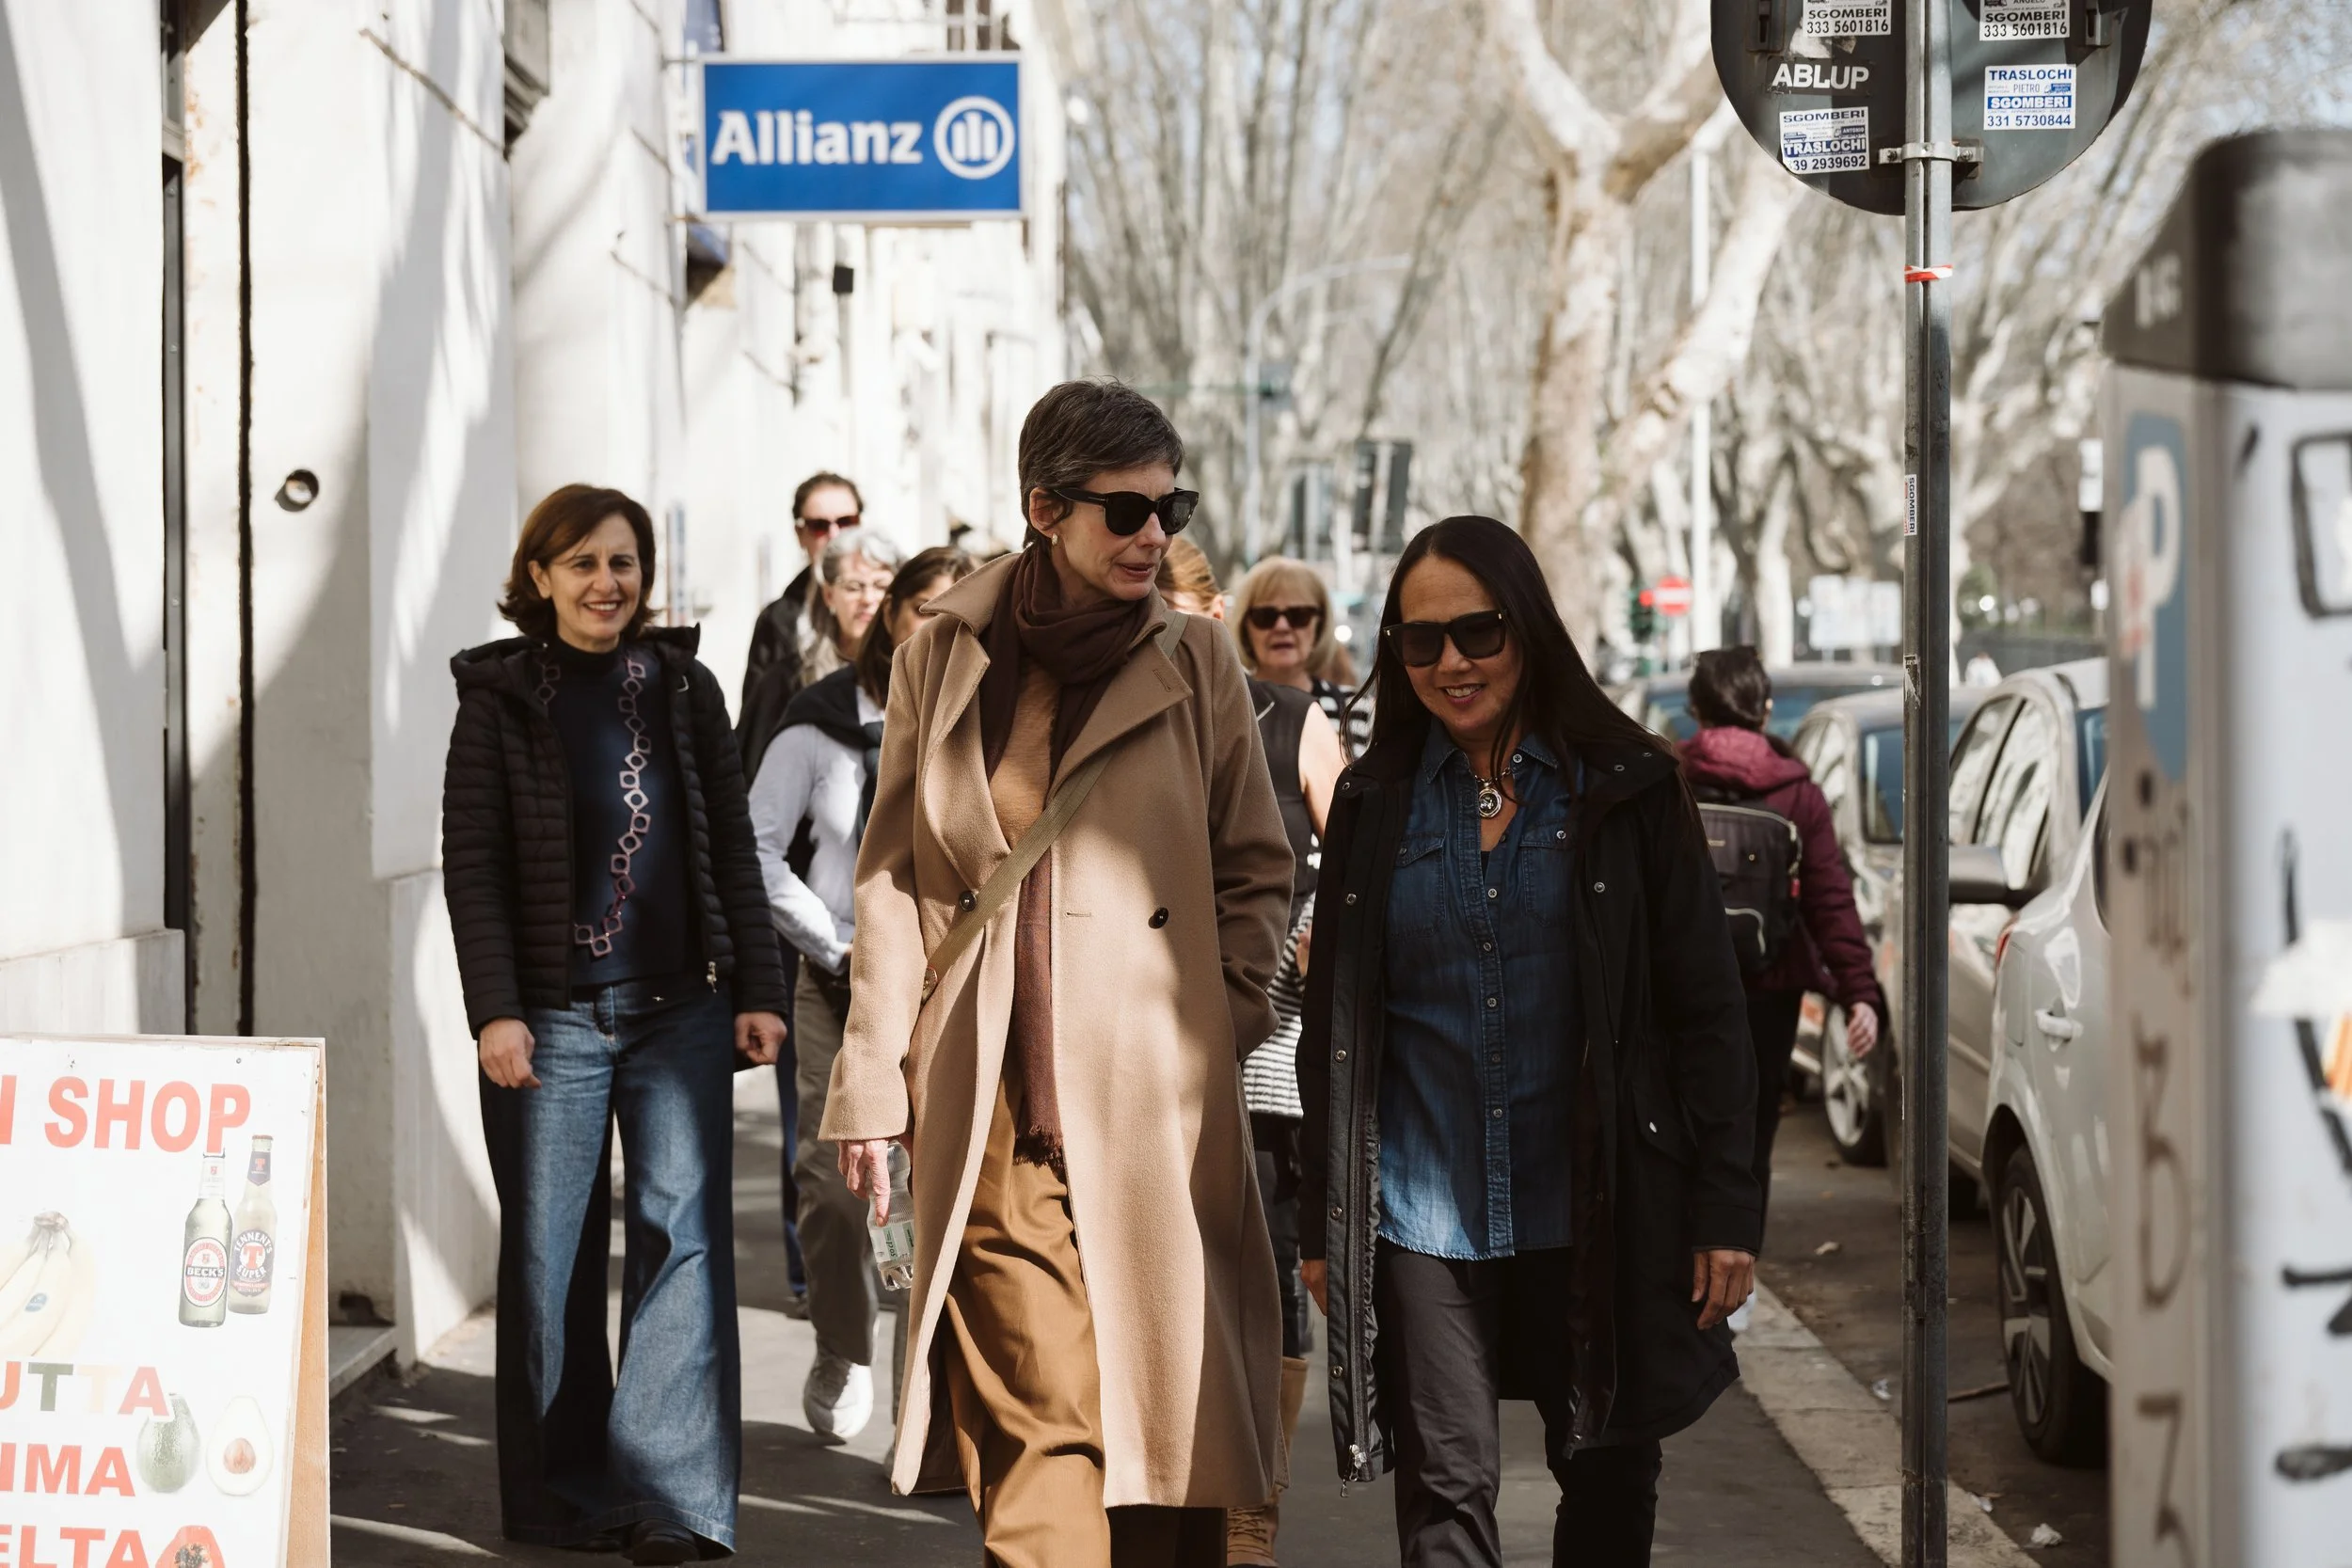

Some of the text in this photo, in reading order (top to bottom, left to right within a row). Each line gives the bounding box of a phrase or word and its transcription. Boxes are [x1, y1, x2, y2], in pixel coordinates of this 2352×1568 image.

[1808, 8, 1887, 19] SGOMBERI
[1985, 10, 2065, 23] SGOMBERI
[1807, 20, 1888, 34] 333 5601816
[1984, 23, 2067, 37] 333 5601816
[1772, 63, 1869, 89] ABLUP
[1989, 69, 2072, 81] TRASLOCHI
[2013, 84, 2041, 93] PIETRO
[1991, 96, 2069, 108] SGOMBERI
[1783, 110, 1865, 123] SGOMBERI
[1987, 115, 2071, 127] 331 5730844
[711, 110, 923, 165] Allianz
[1784, 139, 1866, 155] TRASLOCHI
[1790, 155, 1866, 170] 39 2939692
[44, 1076, 251, 1153] SHOP
[236, 1265, 266, 1278] SUPER
